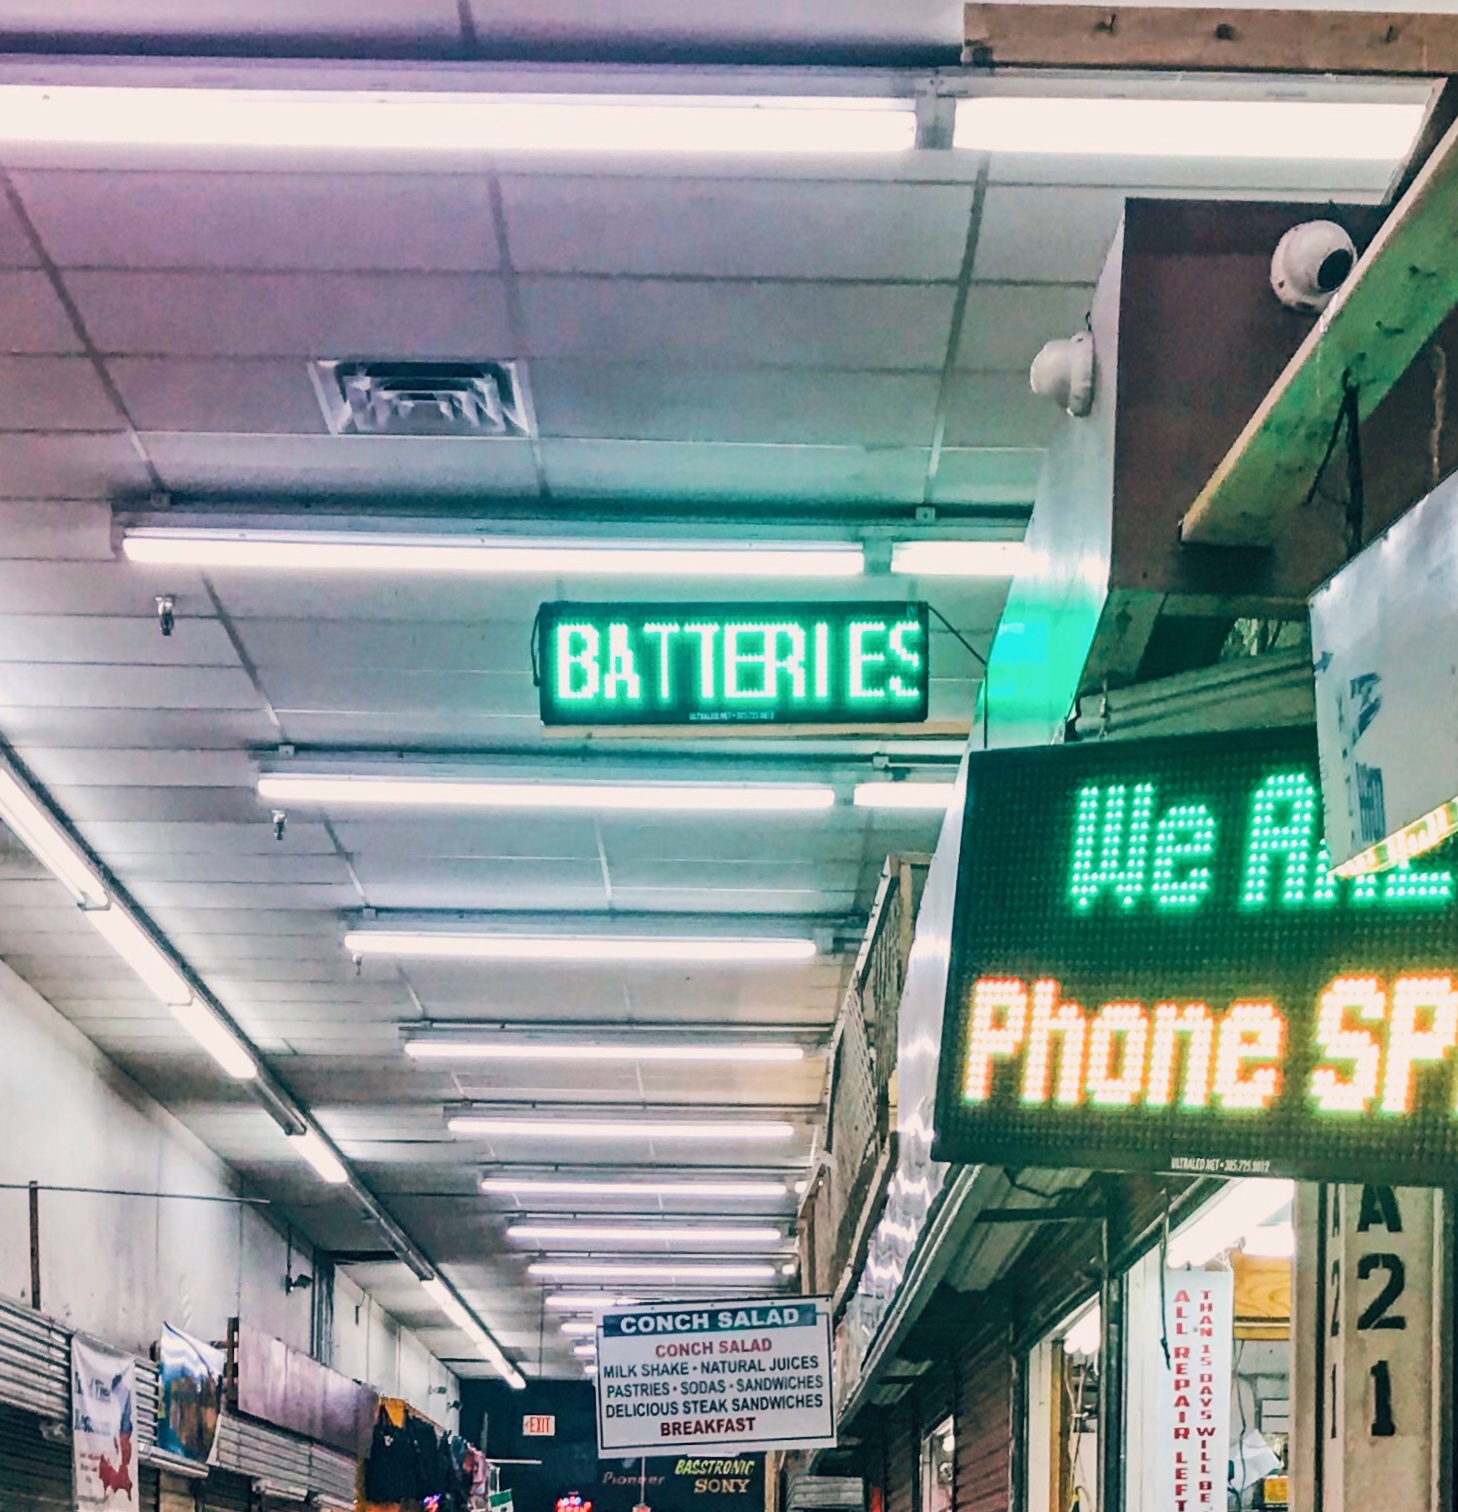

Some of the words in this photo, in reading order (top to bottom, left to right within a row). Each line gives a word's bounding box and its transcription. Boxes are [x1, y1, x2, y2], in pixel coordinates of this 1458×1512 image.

[556, 620, 921, 700] BATTERIES
[1071, 781, 1216, 907] We
[962, 975, 1287, 1111] Phone
[620, 1313, 710, 1334] CONCH
[717, 1307, 800, 1328] SALAD
[1174, 1290, 1190, 1335] ALL
[1199, 1290, 1214, 1337] THAN
[655, 1341, 714, 1358] CONCH
[719, 1337, 773, 1354] SALAD
[603, 1363, 637, 1379] MILK
[641, 1361, 689, 1377] SHAKE
[701, 1358, 766, 1375] NATURAL
[769, 1355, 819, 1372] JUICES
[606, 1382, 670, 1398] PASTRIES
[680, 1379, 726, 1395] SODAS
[736, 1375, 824, 1393] SANDWICHES
[1174, 1346, 1191, 1440] REPAIR
[1199, 1373, 1213, 1421] DAYS
[606, 1401, 679, 1418] DELICIOUS
[682, 1398, 728, 1415] STEAK
[731, 1394, 824, 1412] SANDWICHES
[529, 1416, 551, 1434] EXIT
[660, 1417, 756, 1437] BREAKFAST
[1196, 1427, 1217, 1474] WILL
[602, 1470, 666, 1485] Pioneer
[674, 1458, 755, 1476] BASSTRONIC
[694, 1477, 750, 1493] SONY
[1175, 1451, 1188, 1512] LEFT
[1199, 1480, 1213, 1503] BE
